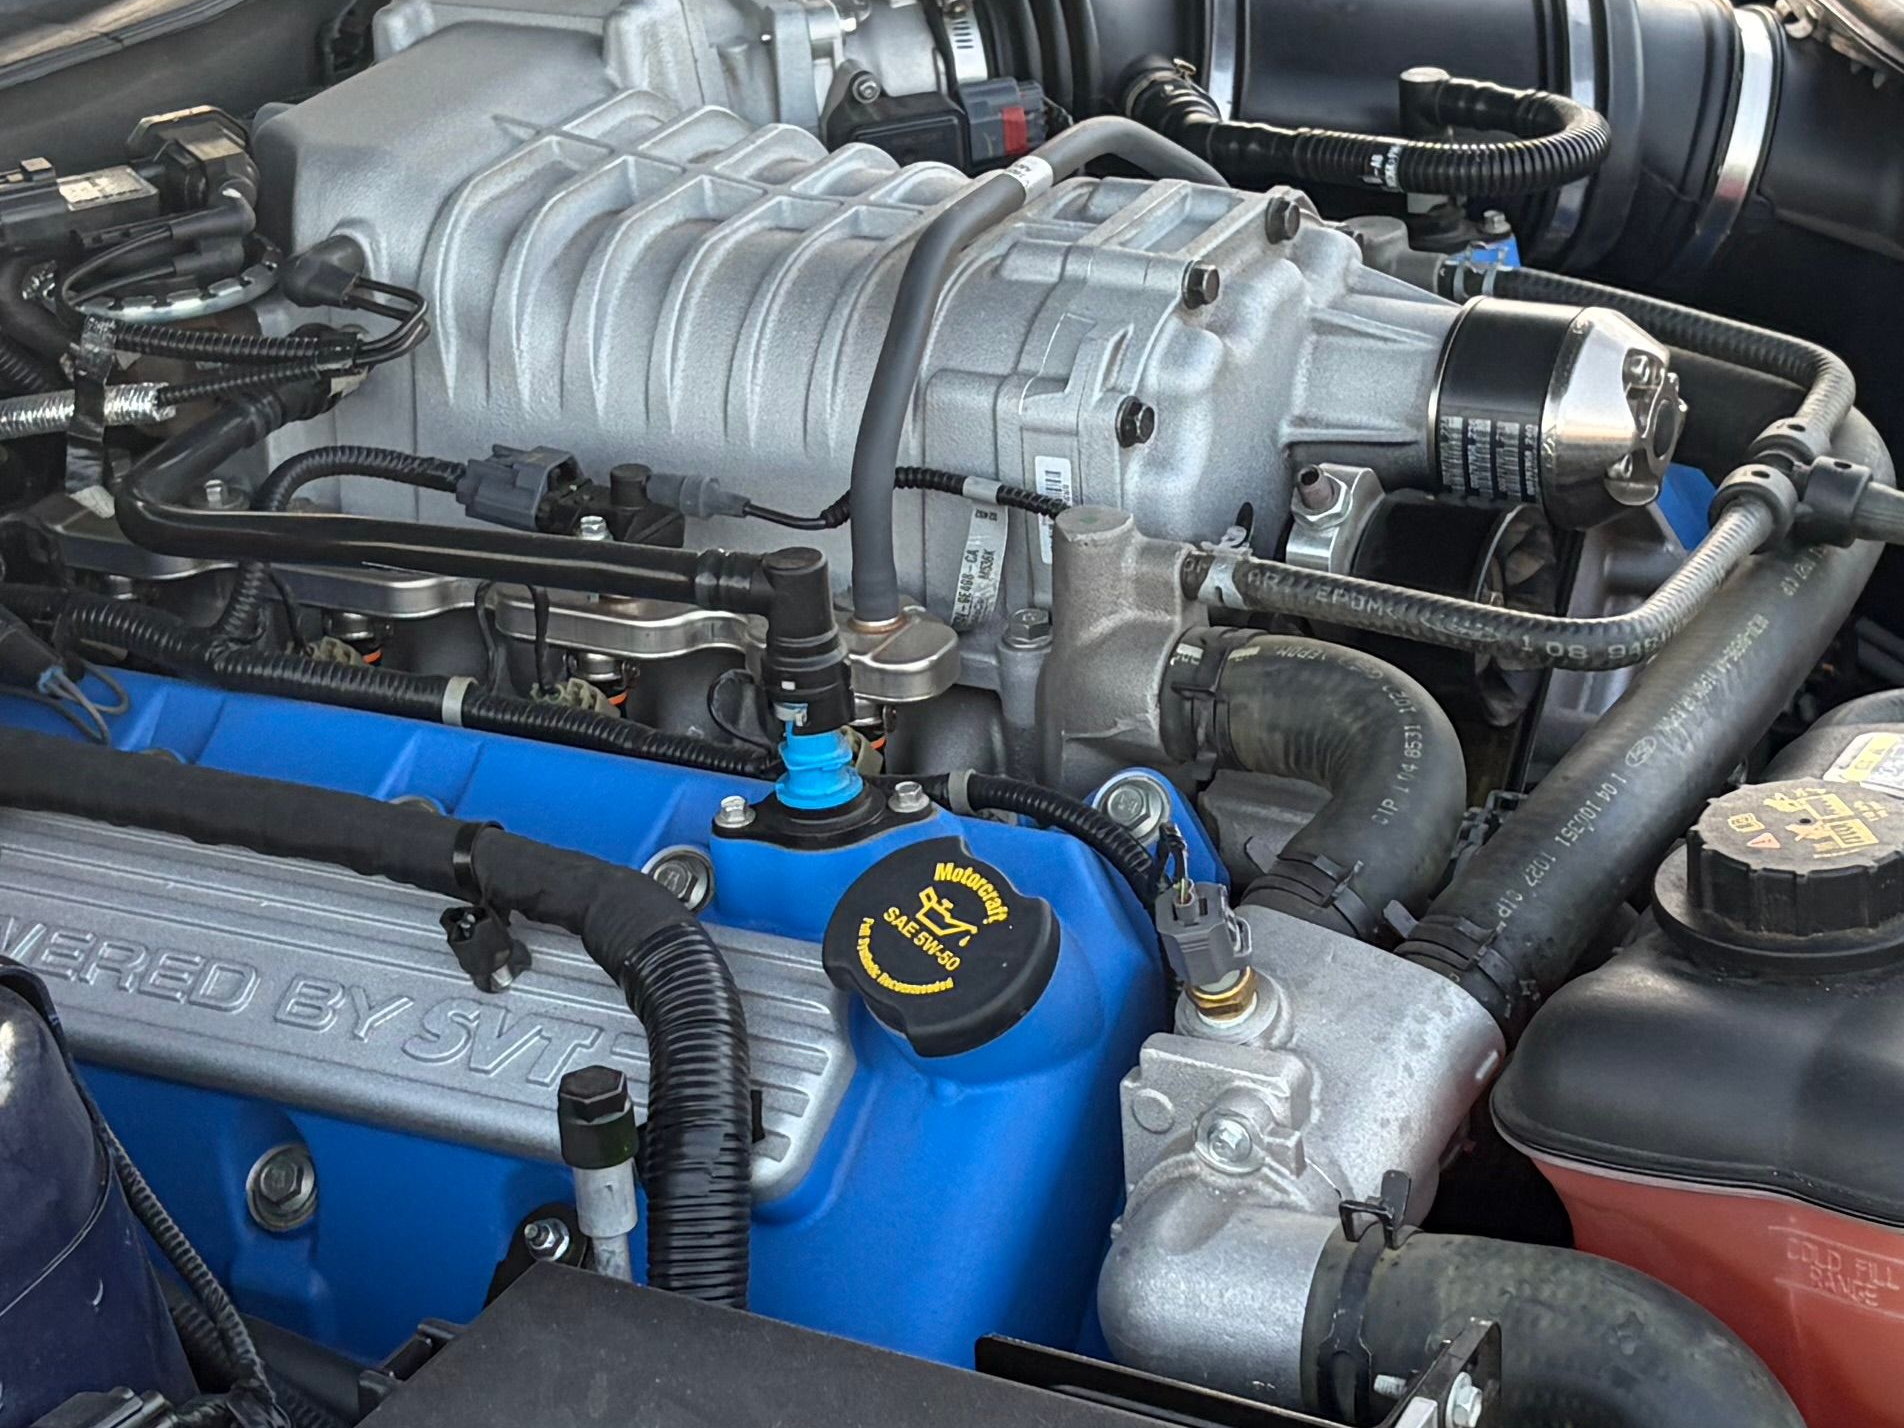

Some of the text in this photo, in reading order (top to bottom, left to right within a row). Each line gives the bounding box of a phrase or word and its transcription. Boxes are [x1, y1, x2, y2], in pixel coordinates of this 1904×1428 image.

[933, 862, 1009, 925] Motorcraft
[883, 906, 961, 971] SAE 5W-50
[273, 976, 415, 1044] BY
[401, 995, 604, 1089] SVT
